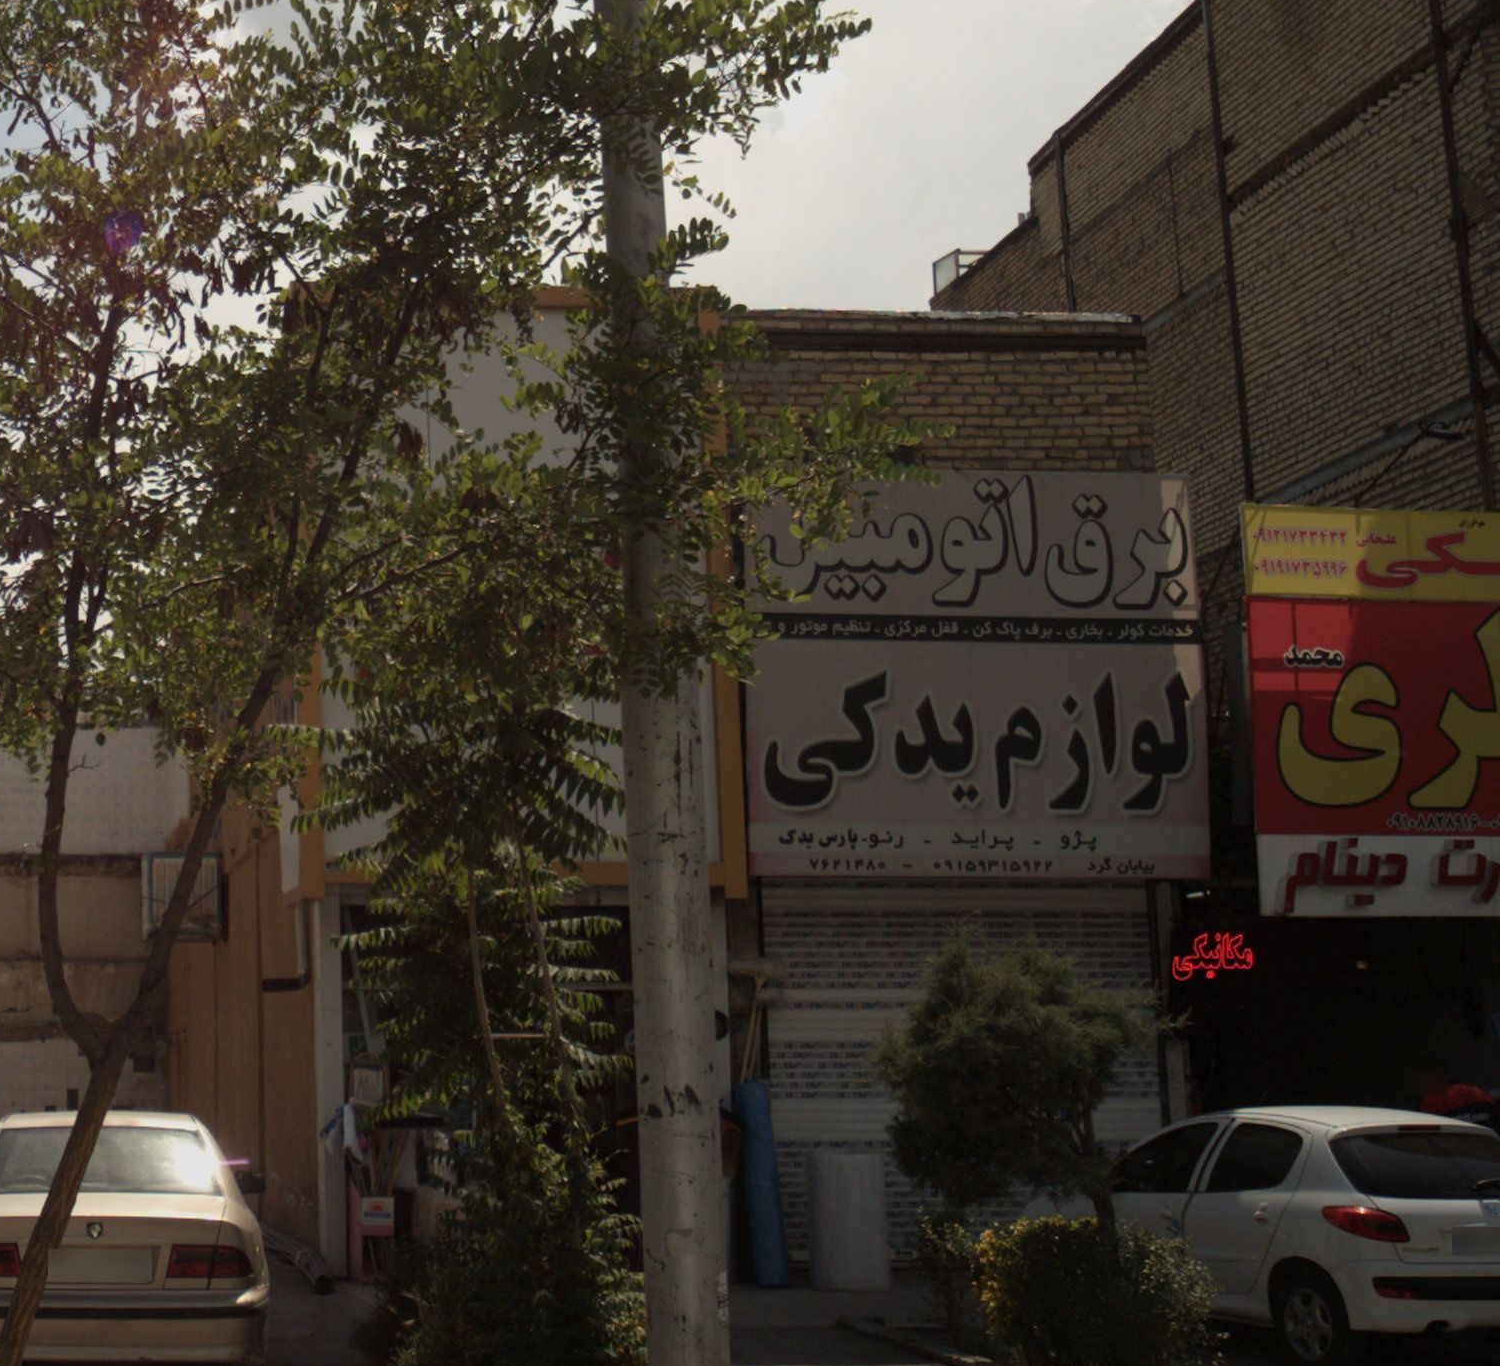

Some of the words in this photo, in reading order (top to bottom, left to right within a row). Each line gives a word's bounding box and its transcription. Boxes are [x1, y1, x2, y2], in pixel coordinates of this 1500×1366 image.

[1042, 493, 1189, 610] برق
[1356, 531, 1500, 588] کی
[790, 619, 828, 636] موتور
[831, 618, 871, 637] تنظیم
[884, 618, 927, 638] مرکزی
[931, 620, 959, 638] قفل
[972, 620, 992, 638] کن
[996, 621, 1021, 640] پاک
[1025, 621, 1052, 640] برف
[1065, 620, 1103, 641] بخاری
[1117, 623, 1145, 641] کولر
[1148, 623, 1194, 638] خدمات
[1284, 646, 1345, 669] محمد
[764, 671, 975, 810] یدکی
[995, 671, 1194, 812] لوازم
[778, 828, 815, 850] یدک
[951, 829, 1015, 850] پراید
[1060, 829, 1098, 851] پژو
[1116, 857, 1156, 876] بیابان
[1284, 838, 1408, 913] دینام
[1172, 933, 1253, 981] مکانیکی
